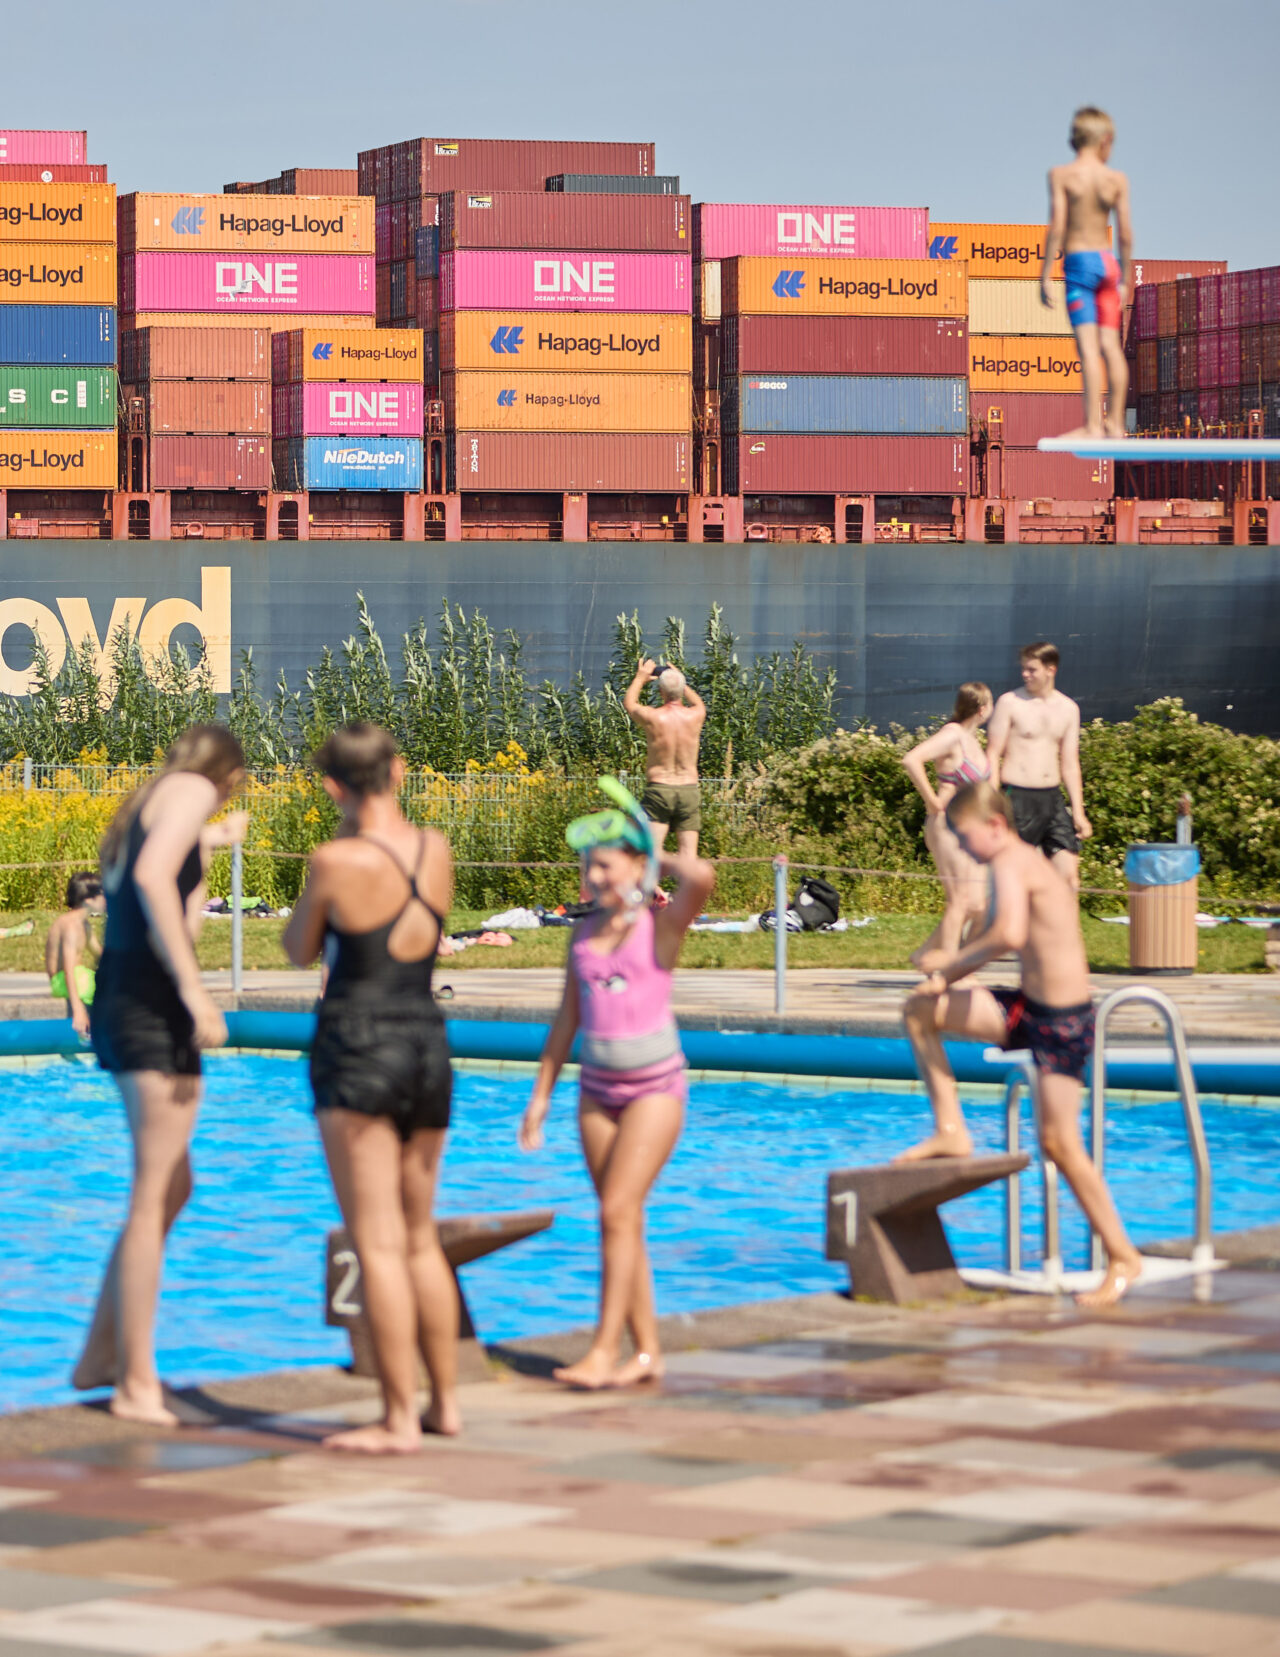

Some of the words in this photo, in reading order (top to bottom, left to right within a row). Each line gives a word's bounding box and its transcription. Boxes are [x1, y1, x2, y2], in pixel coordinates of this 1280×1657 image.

[220, 213, 344, 236] Hapag-Lloyd
[777, 212, 855, 244] ONE
[971, 242, 1063, 264] Hapag-Lo
[216, 262, 298, 294] ONE
[534, 260, 615, 293] ONE
[819, 277, 938, 300] Hapag-Lloyd
[341, 346, 418, 362] Hapag-Lloyd
[538, 332, 660, 356] Hapag-Lloyd
[329, 391, 399, 418] ONE
[526, 394, 600, 407] Hapag-Lloyd
[323, 450, 405, 464] NileDutch
[470, 439, 478, 472] TRITON
[830, 1191, 858, 1248] 1
[330, 1249, 362, 1316] 2
